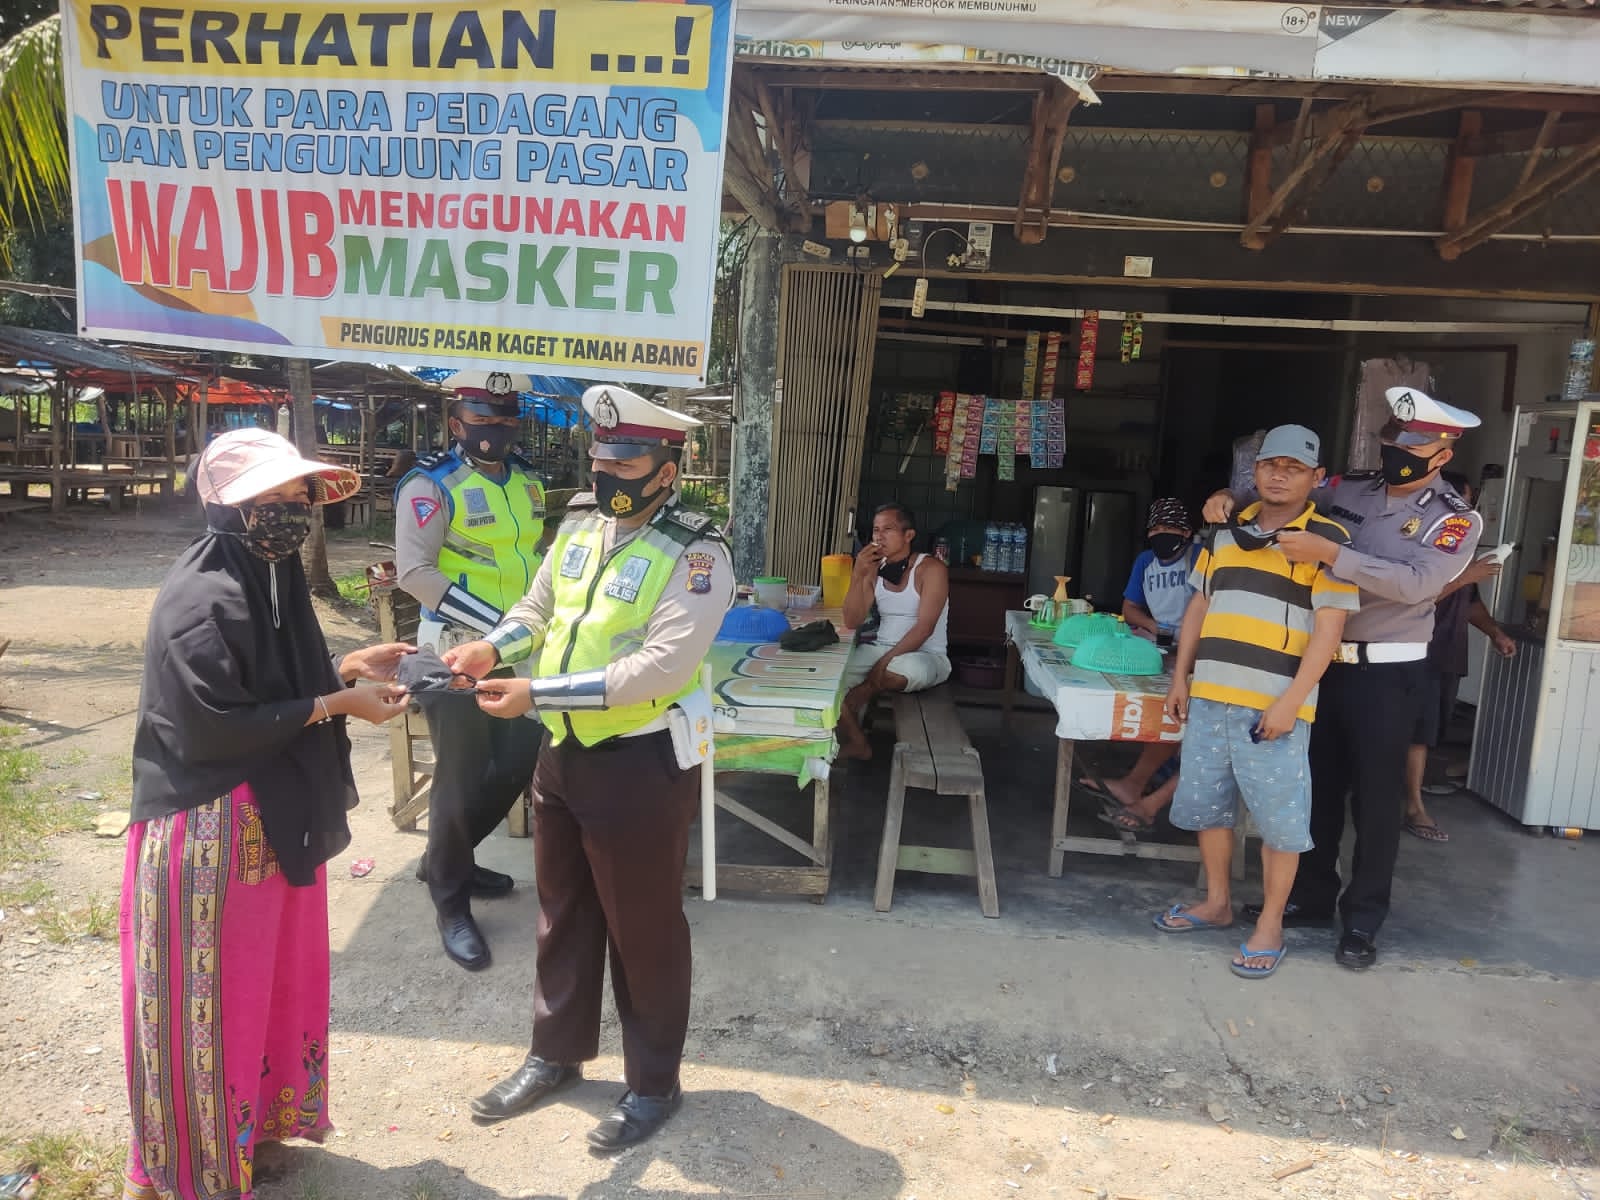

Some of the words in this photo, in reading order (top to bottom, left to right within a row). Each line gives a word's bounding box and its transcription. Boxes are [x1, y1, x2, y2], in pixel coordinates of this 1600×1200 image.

[902, 0, 954, 9] MEROKOK
[959, 1, 1037, 12] MEMBUNUHMU
[1286, 16, 1305, 26] 18+
[1325, 15, 1362, 26] NEW
[90, 4, 557, 70] PERHATIAN
[101, 79, 253, 127] UNTUK
[264, 88, 393, 131] PARA
[404, 91, 678, 142] PEDAGANG
[97, 123, 188, 168] DAN
[193, 130, 501, 178] PENGUNJUNG
[516, 140, 689, 191] PASAR
[106, 178, 338, 300] WAJIB
[338, 189, 687, 243] MENGGUNAKAN
[343, 235, 679, 315] MASKER
[340, 322, 429, 348] PENGURUS
[433, 329, 492, 353] PASAR
[496, 332, 559, 357] KAGET
[562, 337, 627, 363] TANAH
[632, 342, 698, 368] ABANG
